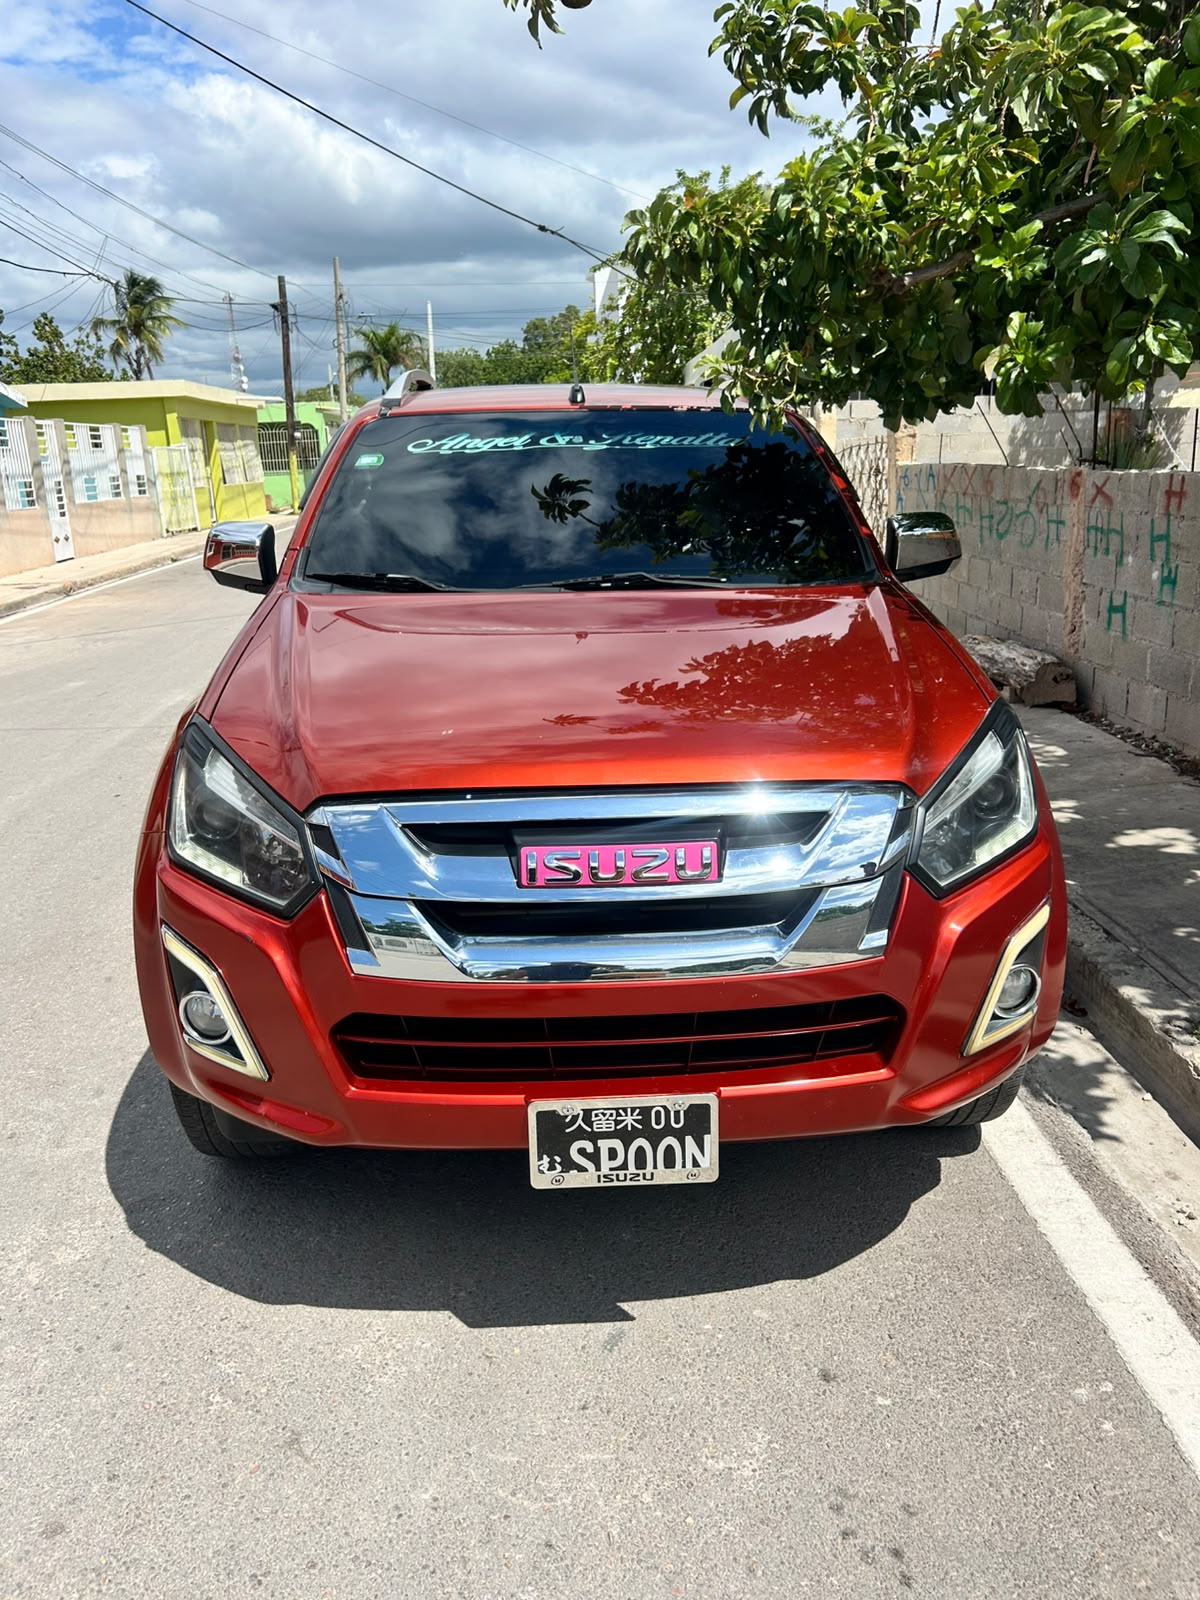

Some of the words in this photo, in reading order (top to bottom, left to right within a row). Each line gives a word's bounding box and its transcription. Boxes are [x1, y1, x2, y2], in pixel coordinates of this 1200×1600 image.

[407, 432, 536, 454] Angel
[526, 846, 712, 885] ISUZU
[569, 1133, 712, 1174] SPOON
[597, 1171, 655, 1184] ISUZU
